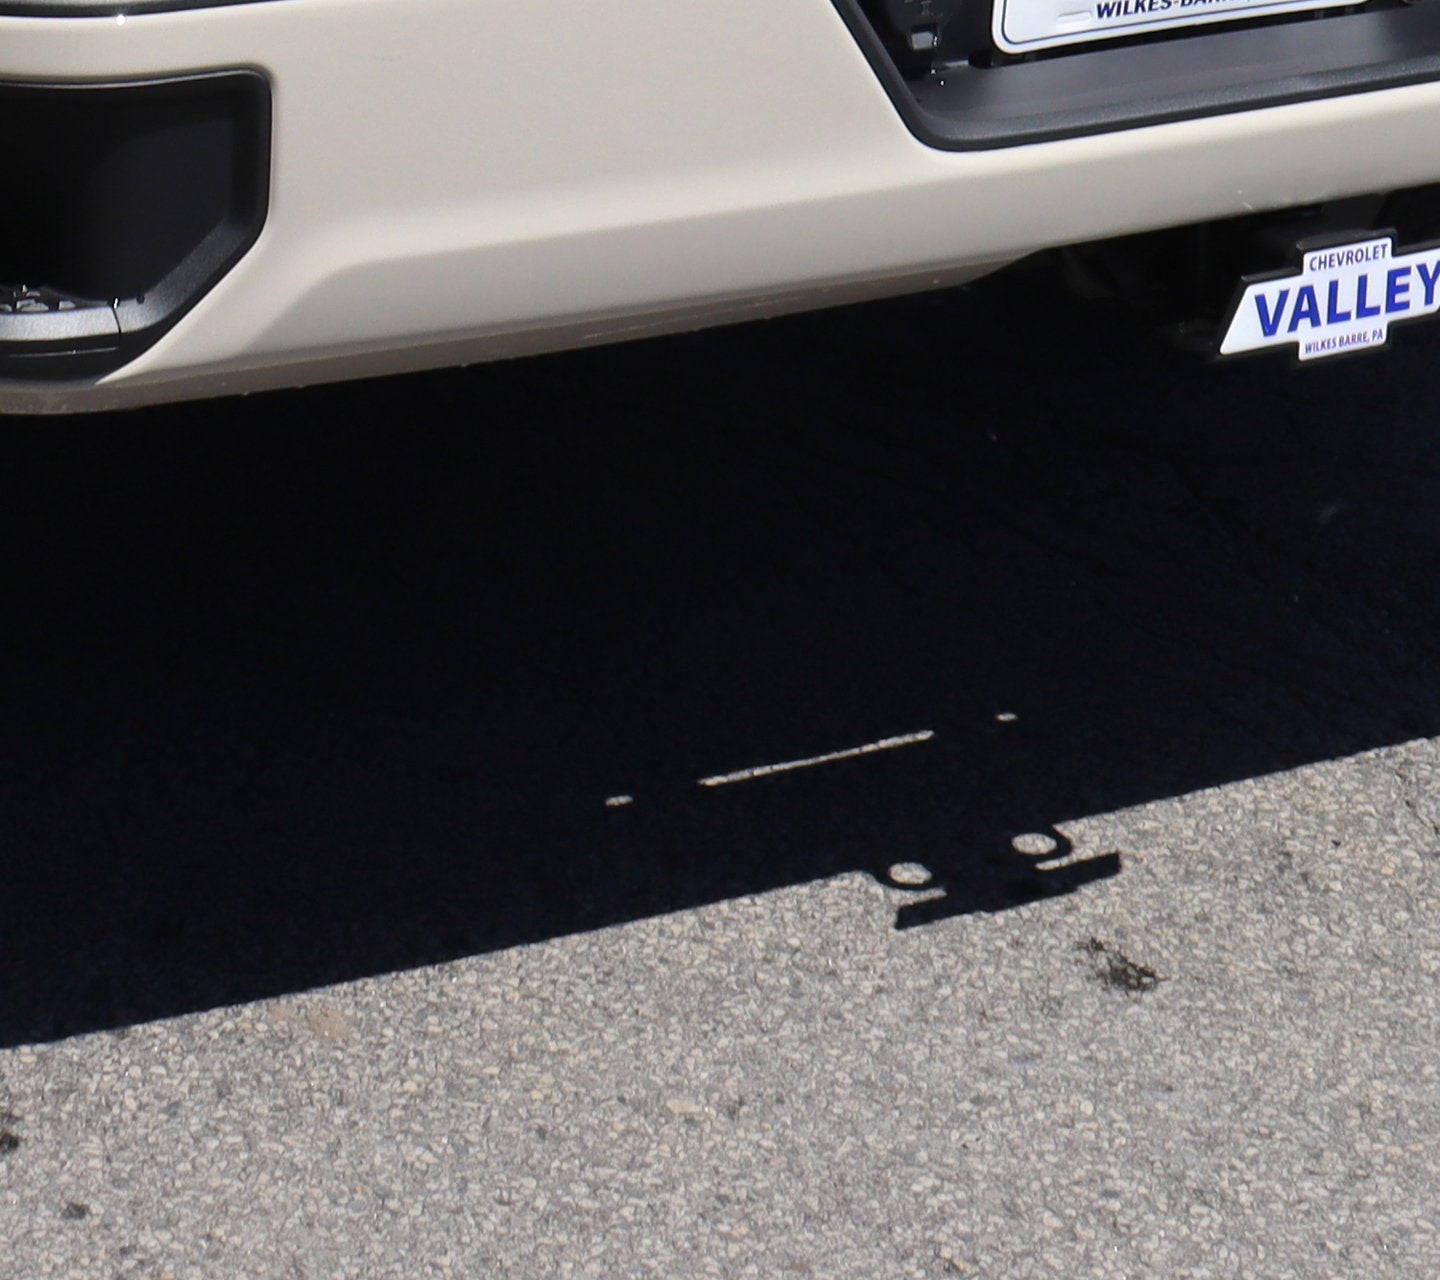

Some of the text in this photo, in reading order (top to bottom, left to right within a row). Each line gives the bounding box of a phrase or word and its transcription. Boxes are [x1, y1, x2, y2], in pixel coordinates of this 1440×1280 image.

[1309, 243, 1388, 272] CHEVROLET
[1304, 328, 1383, 354] WILKES BARRE, PA
